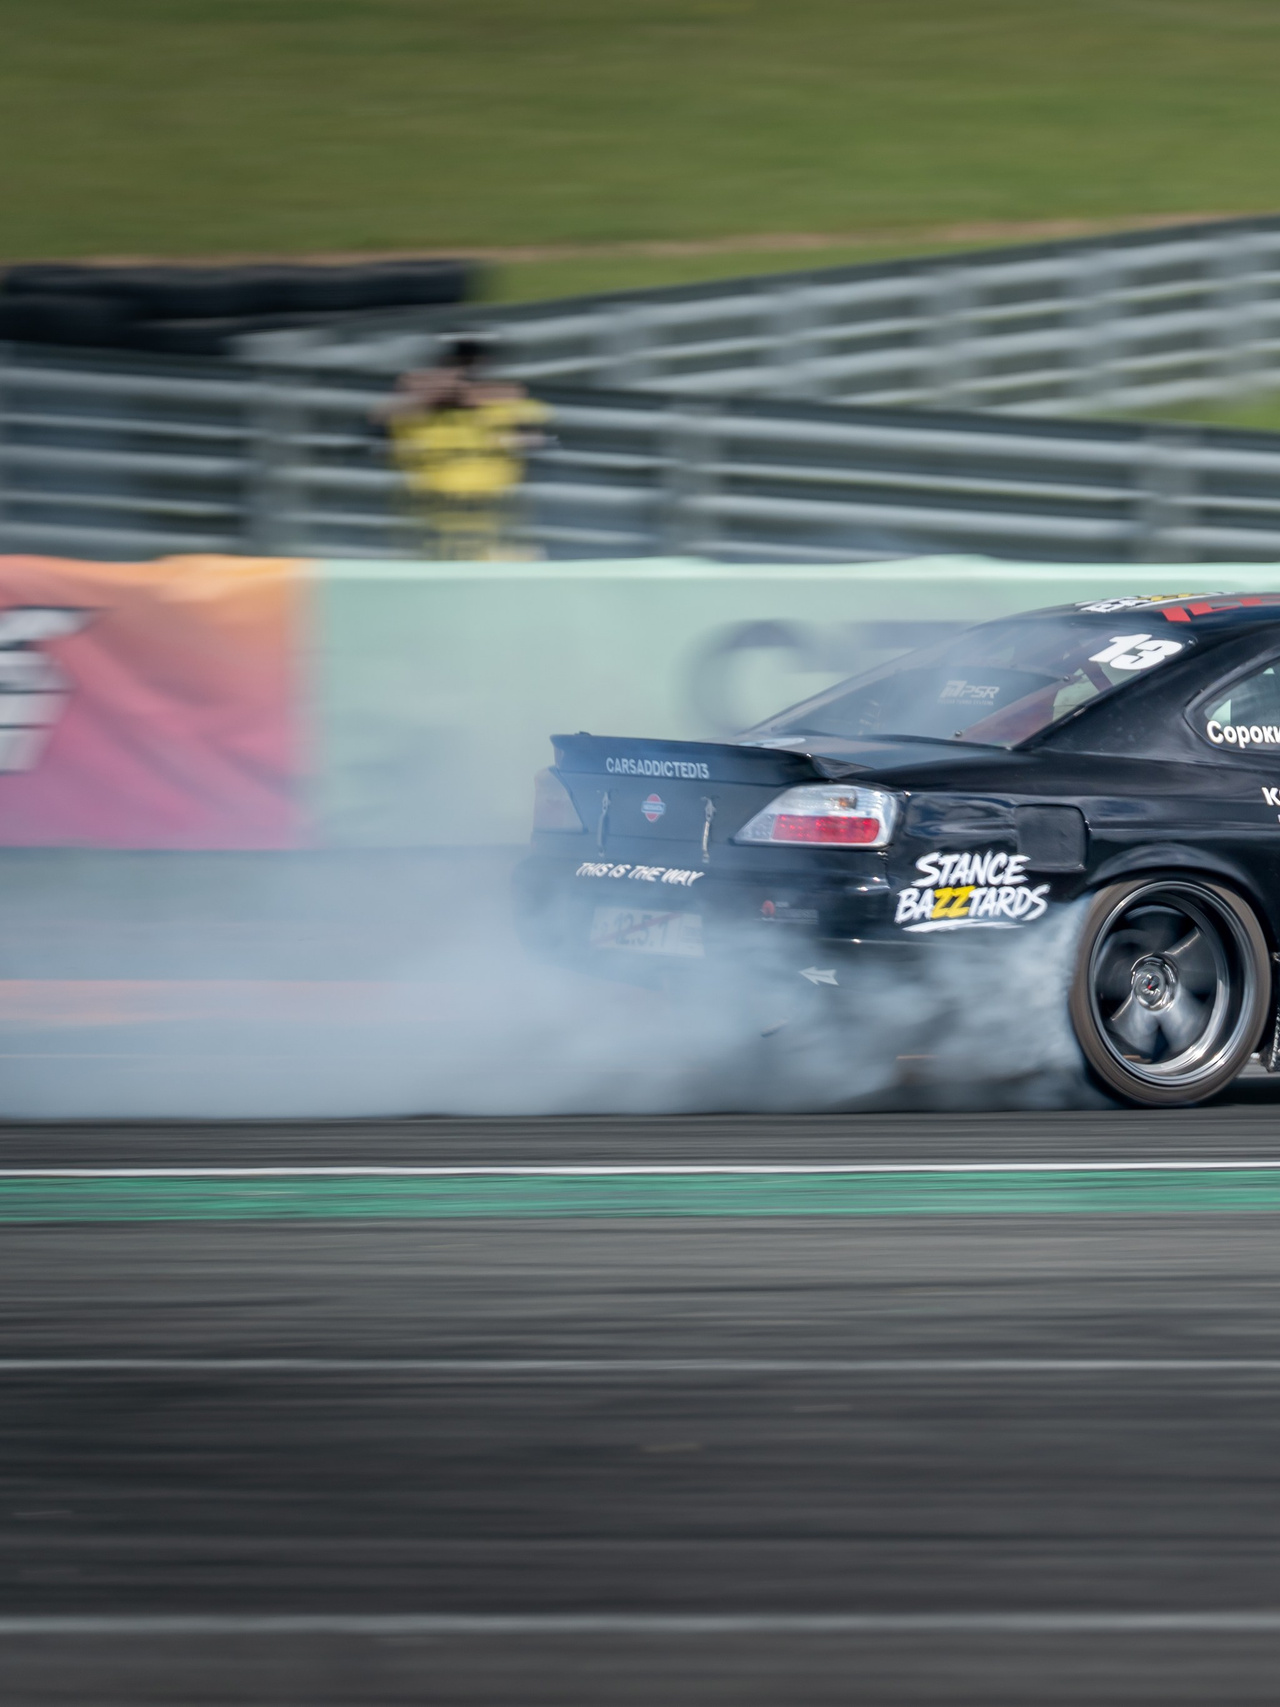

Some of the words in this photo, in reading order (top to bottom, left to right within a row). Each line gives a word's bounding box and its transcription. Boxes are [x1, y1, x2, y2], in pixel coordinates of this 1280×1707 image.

[1089, 634, 1183, 670] 13
[606, 757, 710, 779] CARSADDICTED13
[576, 862, 614, 878] THIS
[608, 863, 632, 879] IS
[628, 865, 666, 882] THE
[661, 868, 705, 887] WAY
[911, 850, 1031, 887] STANCE
[894, 882, 1051, 924] BAZZTARDS
